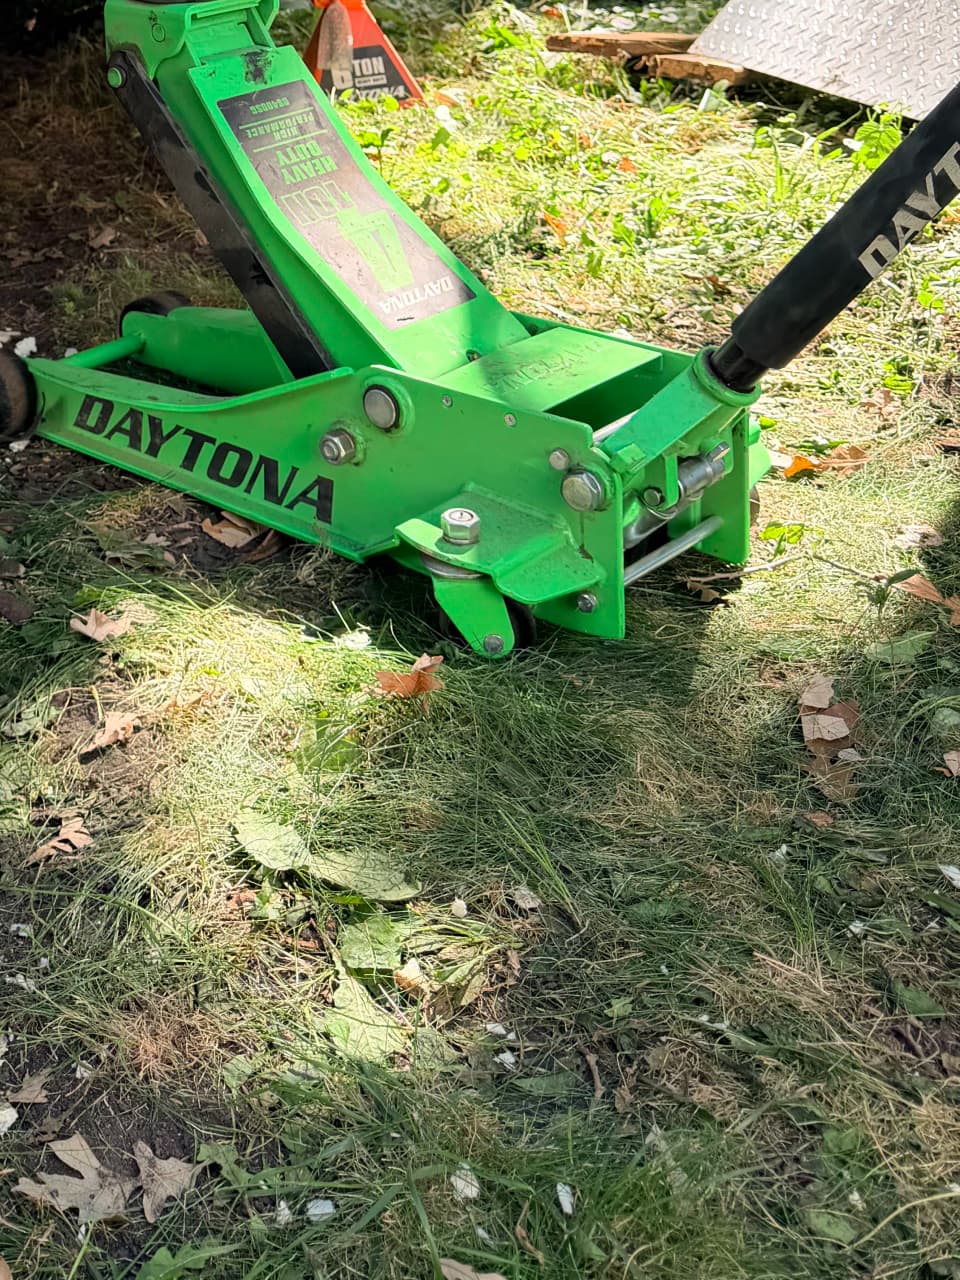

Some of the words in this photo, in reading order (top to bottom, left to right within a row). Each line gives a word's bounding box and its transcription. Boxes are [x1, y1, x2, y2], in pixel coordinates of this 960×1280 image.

[352, 55, 385, 77] TON
[245, 111, 315, 139] PERFORMANCE
[272, 125, 298, 141] HIGH
[276, 140, 322, 167] DUTY
[281, 155, 337, 185] HEAVY
[280, 180, 355, 226] TON
[335, 207, 415, 293] 4
[377, 275, 455, 314] DAYTONA
[73, 394, 335, 524] DAYTONA
